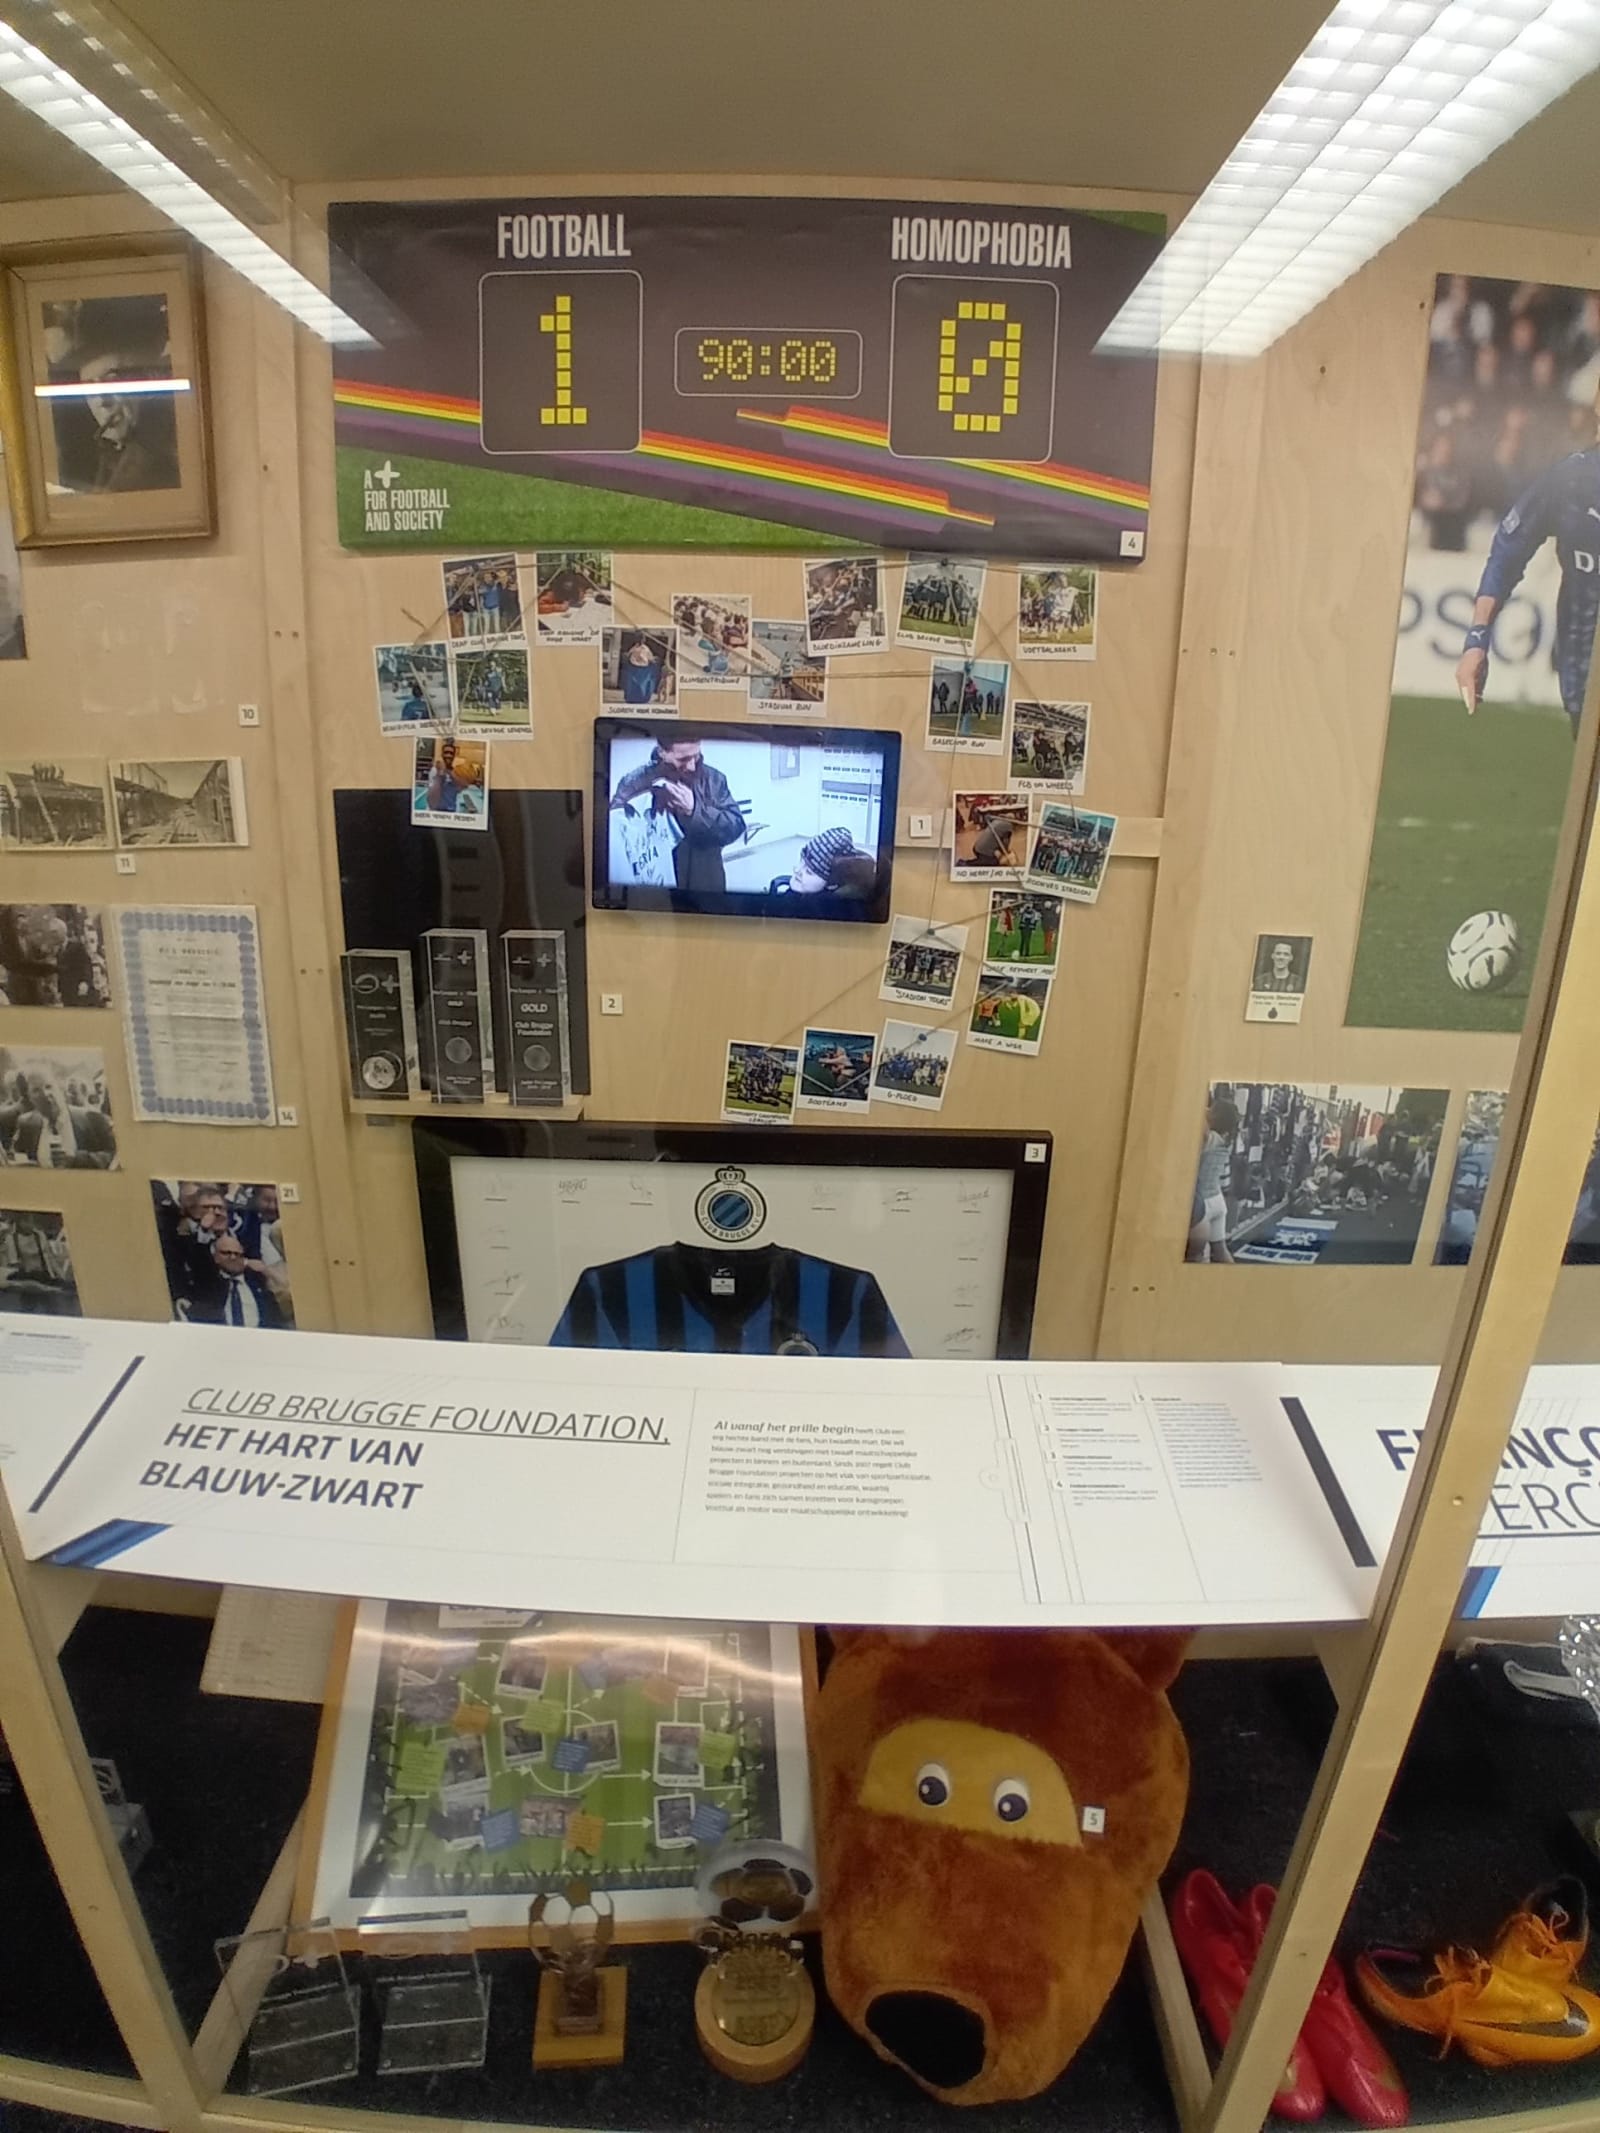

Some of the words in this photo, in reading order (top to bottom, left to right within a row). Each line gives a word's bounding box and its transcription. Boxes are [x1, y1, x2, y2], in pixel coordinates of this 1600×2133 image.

[498, 214, 632, 259] FOOTBALL
[891, 217, 1072, 269] HOMOPHOBIA
[540, 296, 588, 425] 1
[698, 339, 836, 381] 90:00
[938, 301, 1021, 432] 0
[364, 490, 388, 510] FOR
[391, 488, 450, 509] FOOTBALL
[365, 511, 391, 532] AND
[394, 510, 444, 531] SOCIETY
[1128, 537, 1136, 549] 4
[241, 708, 255, 720] 10
[521, 1003, 548, 1014] GOLD
[608, 998, 616, 1009] 2
[281, 1111, 293, 1121] 14
[1031, 1147, 1039, 1159] 3
[702, 1216, 718, 1234] CLUB
[718, 1228, 751, 1239] BRUGGE
[187, 1387, 274, 1416] CLUB
[278, 1394, 425, 1428] BRUGGE
[429, 1405, 669, 1445] FOUNDATION,
[714, 1420, 728, 1430] Al
[731, 1422, 764, 1433] vanaf
[767, 1422, 786, 1432] het
[789, 1423, 819, 1434] prille
[822, 1424, 854, 1435] begin
[164, 1422, 237, 1451] HET
[239, 1429, 341, 1461] HART
[348, 1438, 424, 1467] VAN
[139, 1460, 424, 1510] BLAUW-ZWART
[1090, 1812, 1098, 1826] 5
